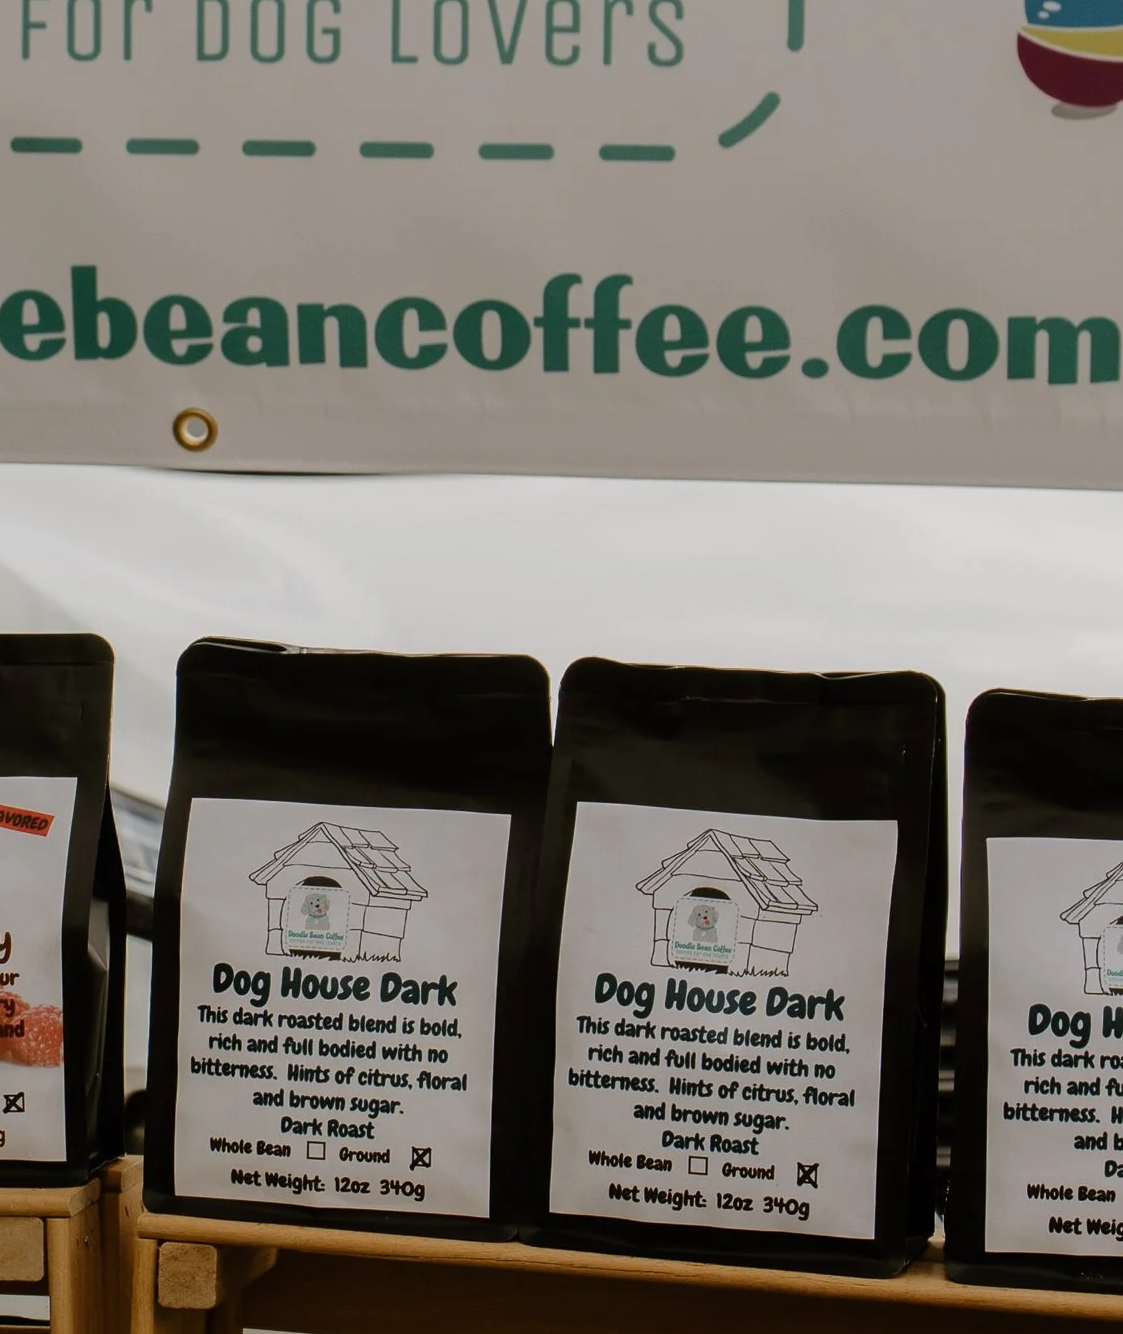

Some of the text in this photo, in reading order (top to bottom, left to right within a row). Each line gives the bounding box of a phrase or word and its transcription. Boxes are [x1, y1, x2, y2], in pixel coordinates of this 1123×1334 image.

[213, 963, 458, 1008] Dog House Dark
[595, 973, 845, 1021] Dog House Dark
[197, 1005, 462, 1039] This dark roasted blend is bold,
[1028, 1004, 1091, 1049] Dog
[588, 1044, 836, 1079] rich and full bodied with no
[1010, 1048, 1095, 1069] This dark
[281, 1116, 375, 1139] Dark Roast
[1003, 1102, 1100, 1123] bitterness.
[589, 1150, 775, 1180] Whole Bean Ground
[231, 1169, 262, 1187] Net
[334, 1177, 371, 1194] 12oz
[380, 1179, 425, 1202] 340g
[1027, 1184, 1116, 1203] Whole Bean
[1048, 1216, 1082, 1235] Net
